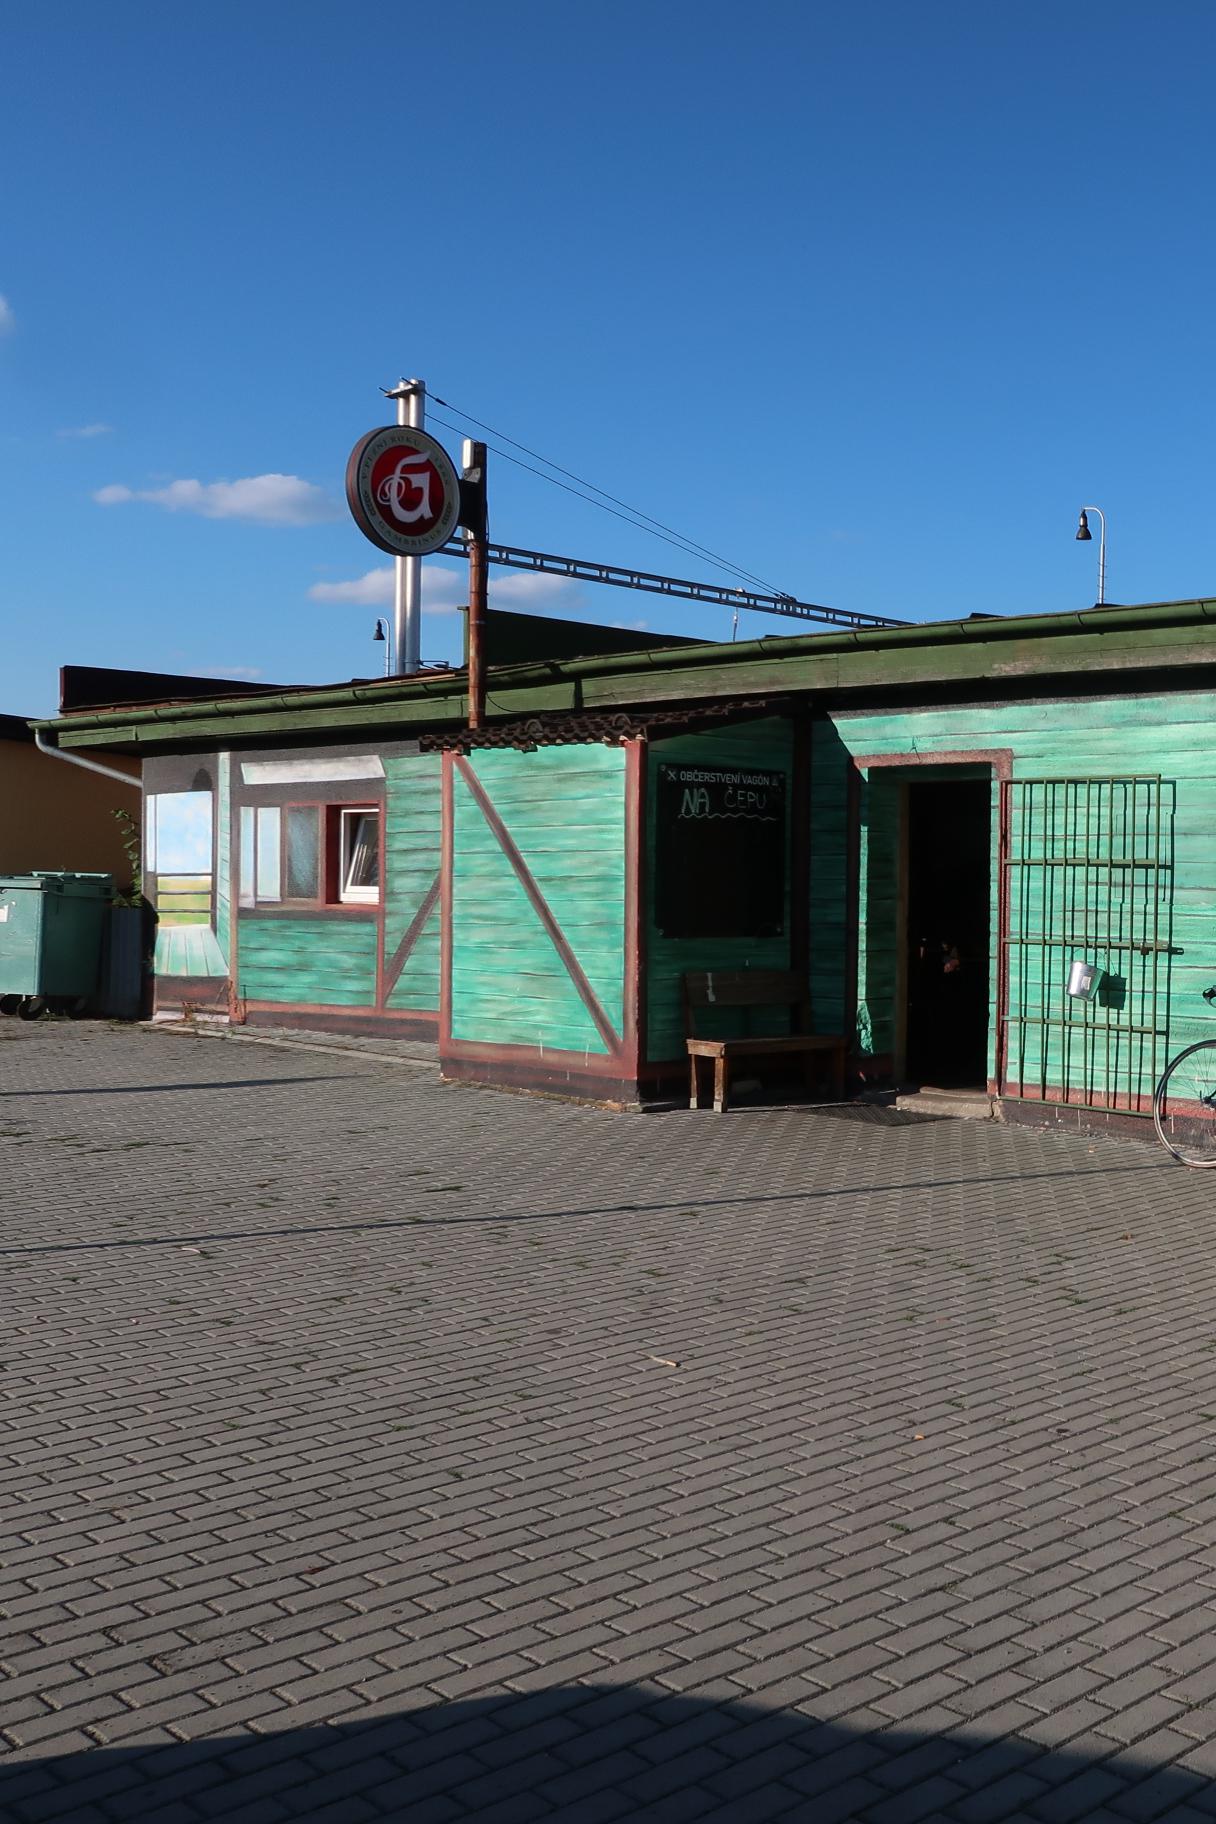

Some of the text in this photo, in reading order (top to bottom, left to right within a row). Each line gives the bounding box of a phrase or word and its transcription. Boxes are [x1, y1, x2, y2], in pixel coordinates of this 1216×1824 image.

[679, 769, 741, 785] OBČERSTVENÍ
[680, 785, 768, 814] NA ČEPU
